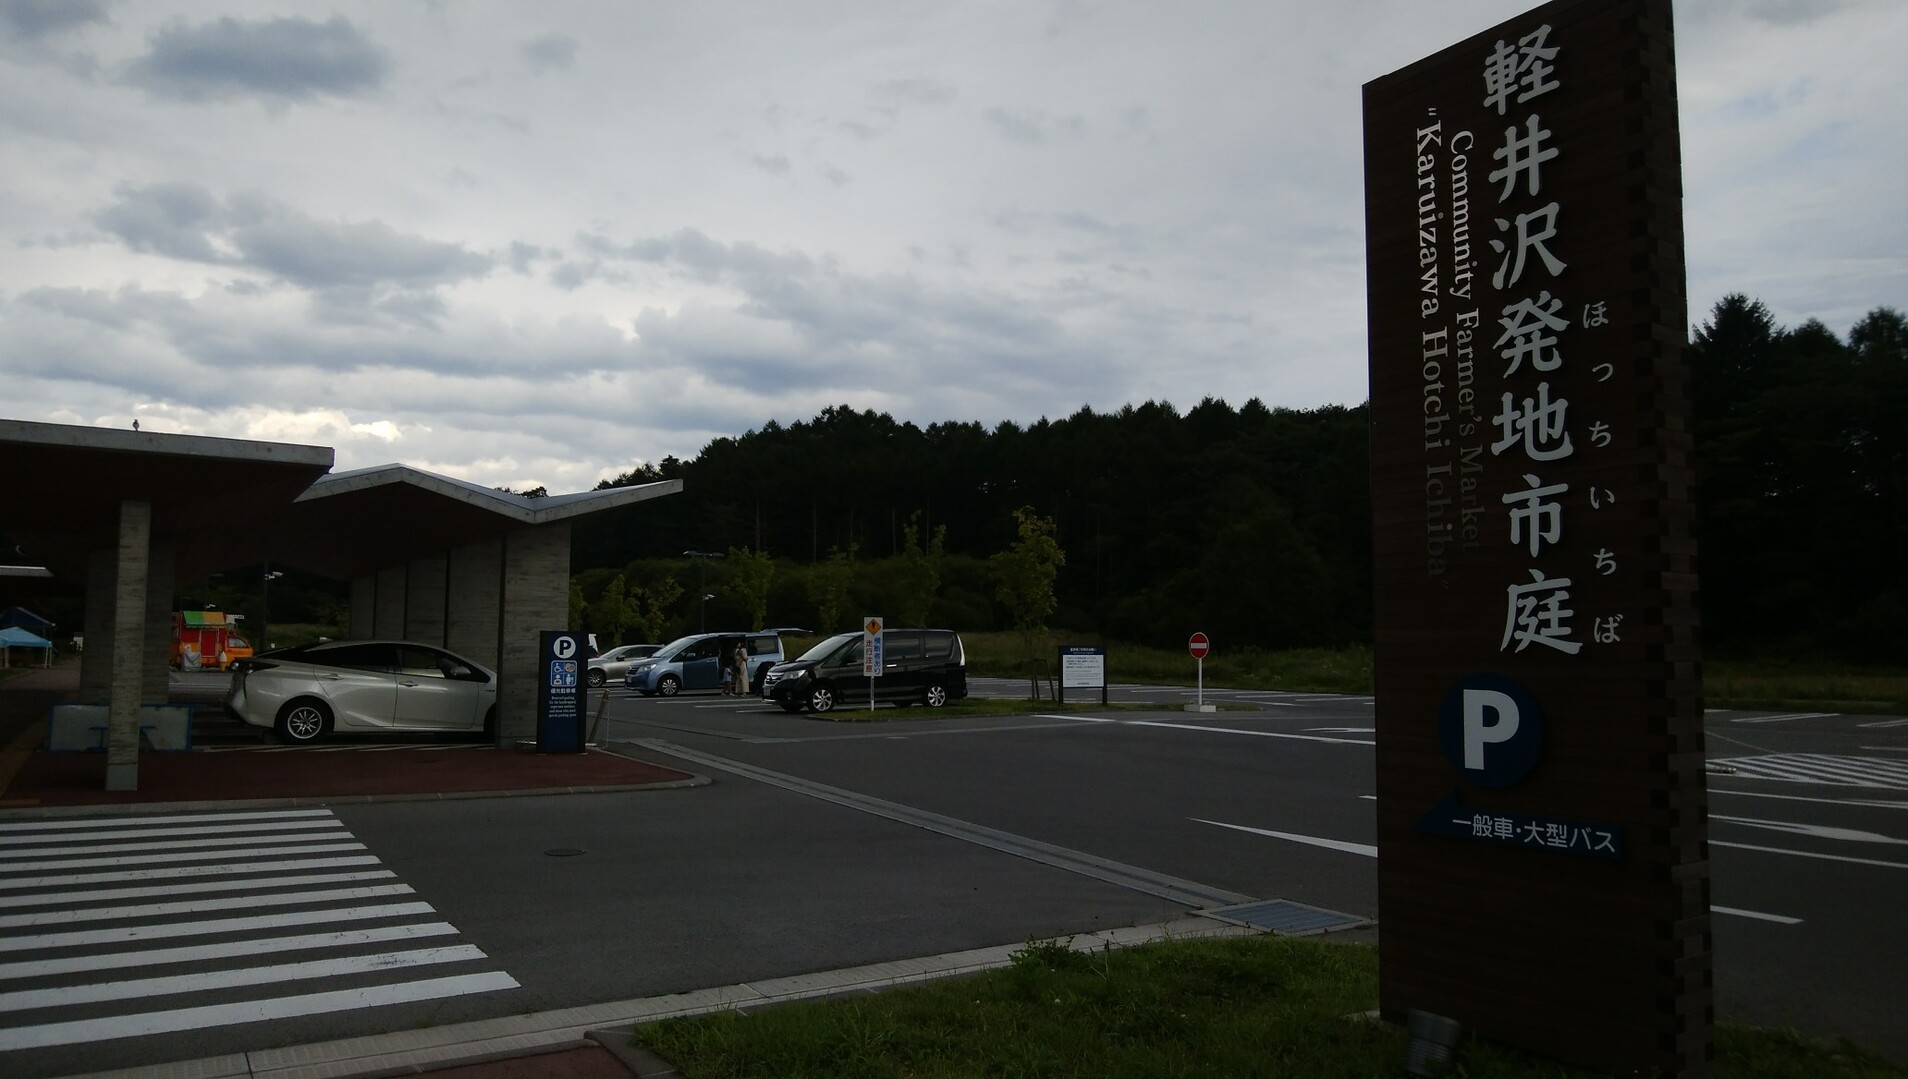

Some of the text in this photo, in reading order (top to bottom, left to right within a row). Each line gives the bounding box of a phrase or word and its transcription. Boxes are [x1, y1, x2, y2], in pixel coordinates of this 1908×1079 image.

[1422, 326, 1451, 453] Hotchi
[1449, 130, 1486, 552] Community Farmer's Market
[1482, 23, 1584, 655] 軽井沢発地市庭
[559, 640, 572, 656] P
[1462, 688, 1520, 770] P
[1452, 813, 1616, 853] 一般車・大型バス
